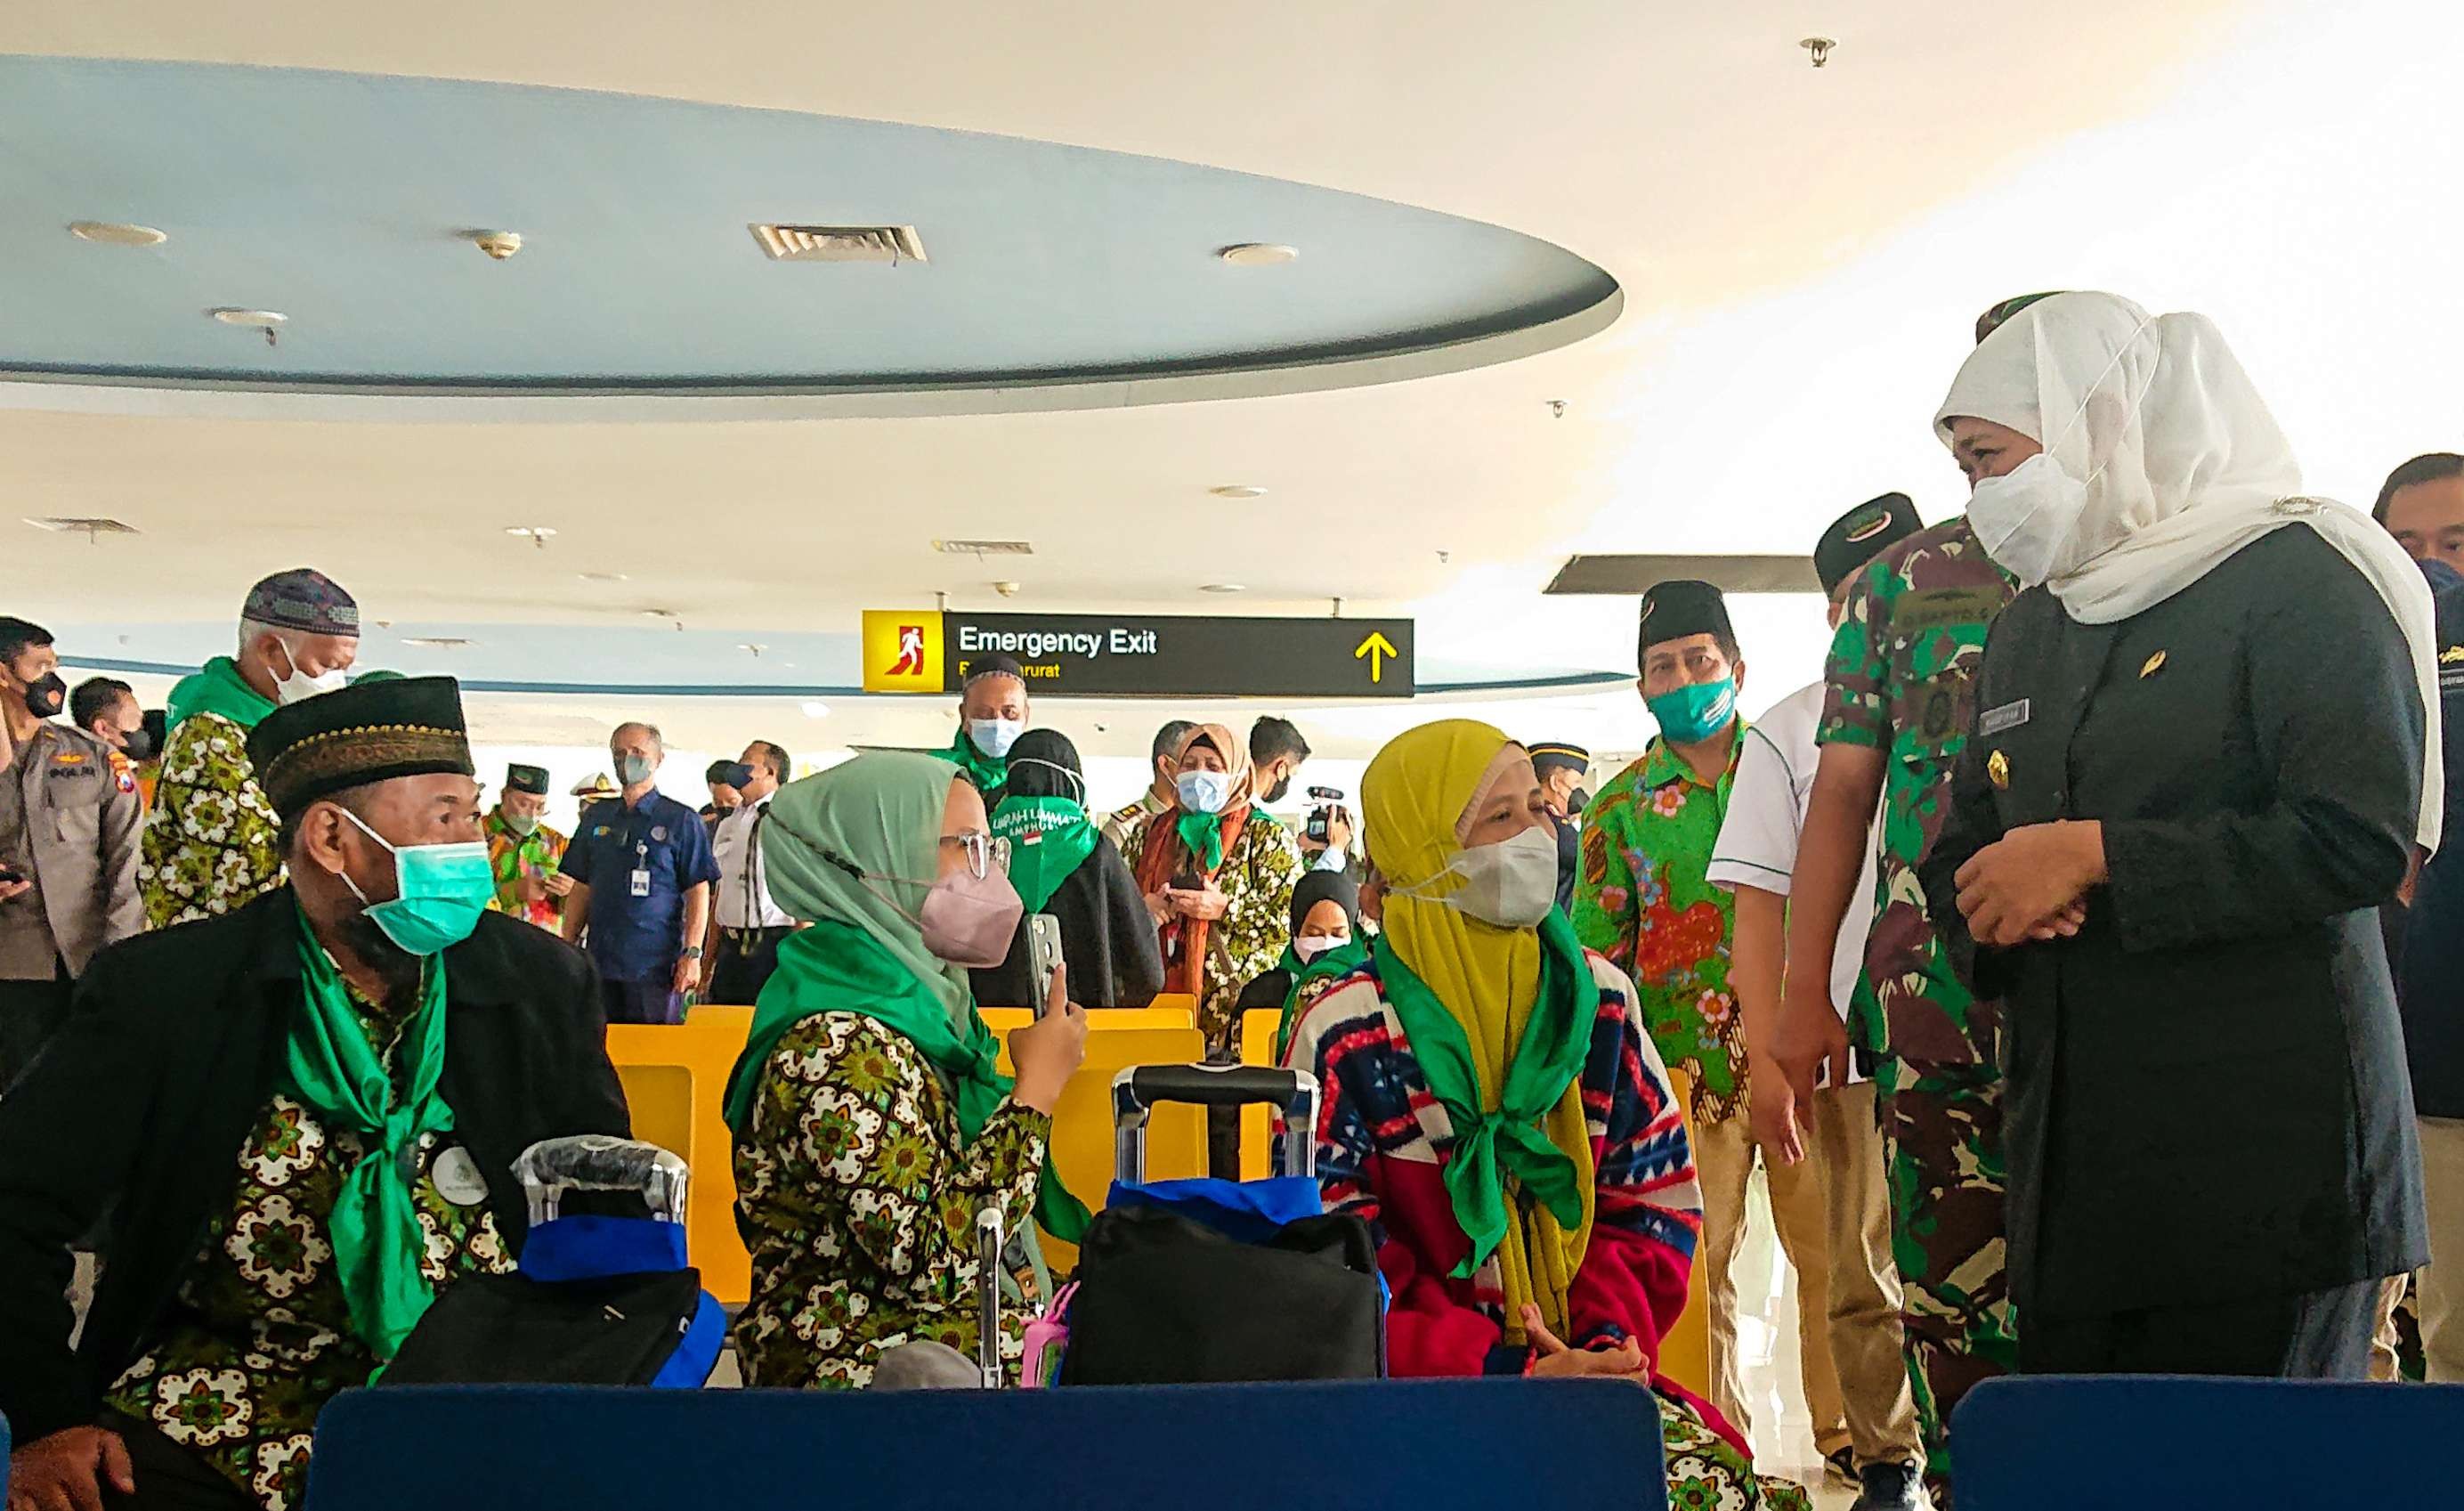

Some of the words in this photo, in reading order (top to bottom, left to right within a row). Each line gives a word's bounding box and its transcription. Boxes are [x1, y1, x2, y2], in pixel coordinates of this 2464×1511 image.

[960, 626, 1101, 658] Emergency
[1110, 629, 1156, 654] Exit
[1019, 663, 1059, 678] rurat
